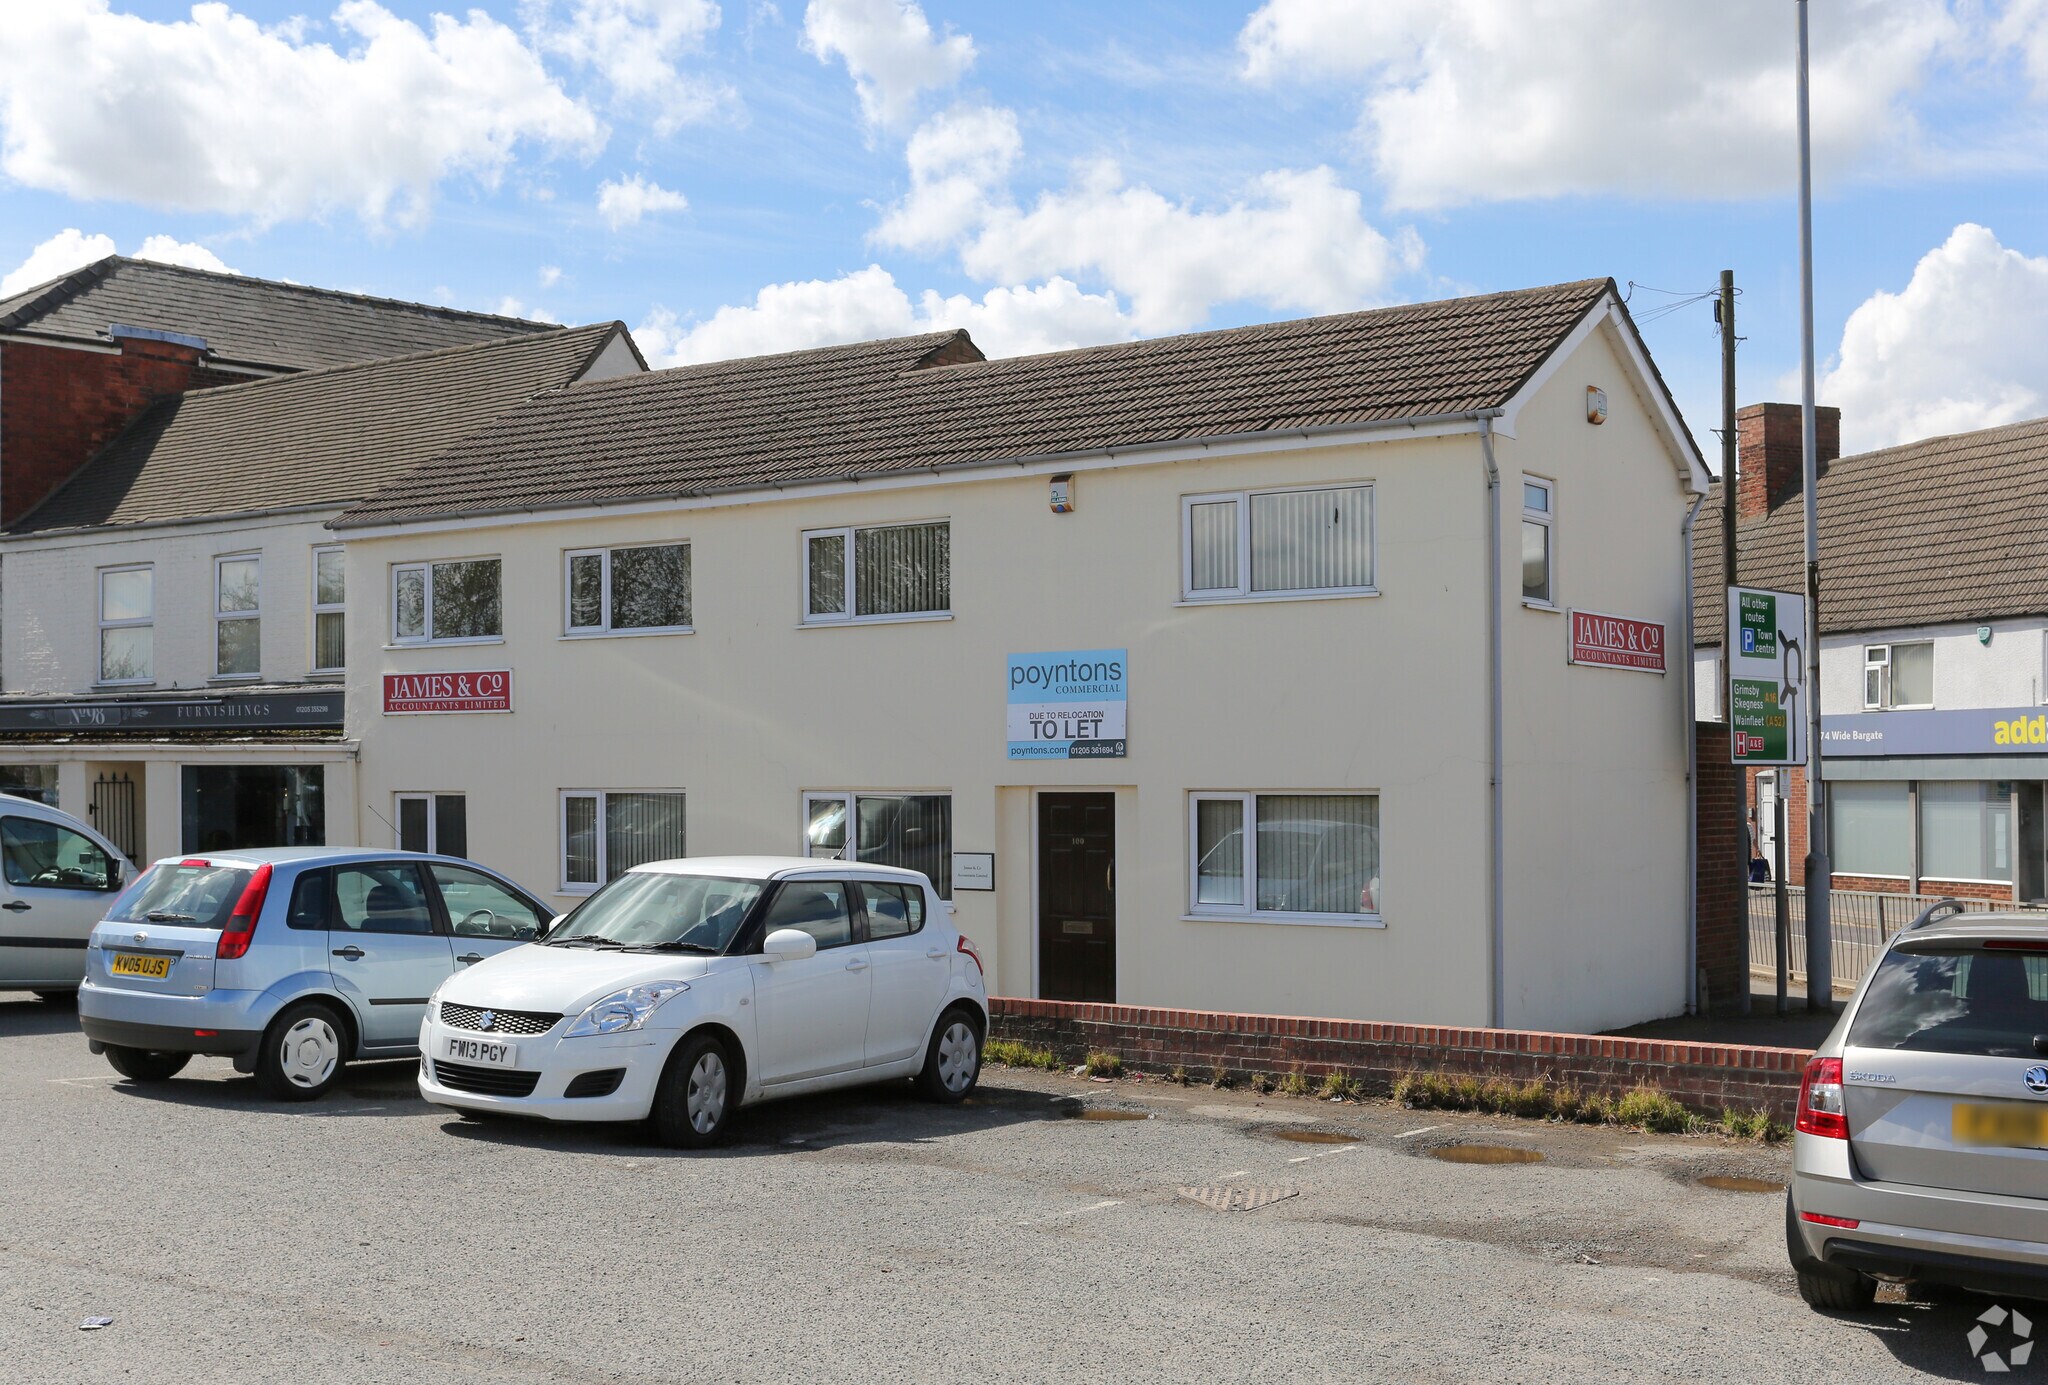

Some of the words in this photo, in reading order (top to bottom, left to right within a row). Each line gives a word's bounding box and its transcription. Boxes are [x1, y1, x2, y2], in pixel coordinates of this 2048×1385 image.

[1741, 596, 1751, 608] All
[1752, 598, 1768, 610] other
[1745, 612, 1766, 623] routes
[1577, 616, 1625, 648] JAMES
[1628, 624, 1639, 650] &
[1744, 630, 1753, 650] P
[1757, 628, 1773, 640] Town
[1755, 643, 1775, 654] centre
[1575, 649, 1630, 664] ACCOUNTANTS
[1633, 656, 1662, 668] LIMITED
[1011, 659, 1122, 690] poyntons
[391, 675, 453, 699] JAMES
[457, 675, 472, 697] &
[1055, 684, 1121, 694] COMMERCIAL
[1734, 684, 1760, 698] Grimsby
[1734, 697, 1764, 711] Skegness
[1764, 692, 1777, 704] A16
[177, 704, 270, 718] FURNISHINGS
[389, 701, 460, 711] ACCOUNTANTS
[464, 700, 506, 709] LIMITED
[1046, 712, 1056, 720] TO
[1058, 710, 1104, 719] RELOCATION
[1734, 714, 1765, 726] Wainfleet
[1030, 720, 1058, 739] TO
[1064, 718, 1103, 739] LET
[1994, 715, 2048, 745] add
[1831, 730, 1850, 740] Wide
[1852, 730, 1883, 742] Bargate
[1011, 745, 1068, 756] poyntons.com
[1070, 746, 1090, 755] 01205
[1091, 746, 1114, 754] 361694
[1736, 734, 1746, 754] H
[1072, 837, 1085, 846] 100
[115, 956, 140, 972] KV05
[142, 958, 165, 975] UJS
[449, 1039, 478, 1059] FW13
[480, 1043, 508, 1063] PGY
